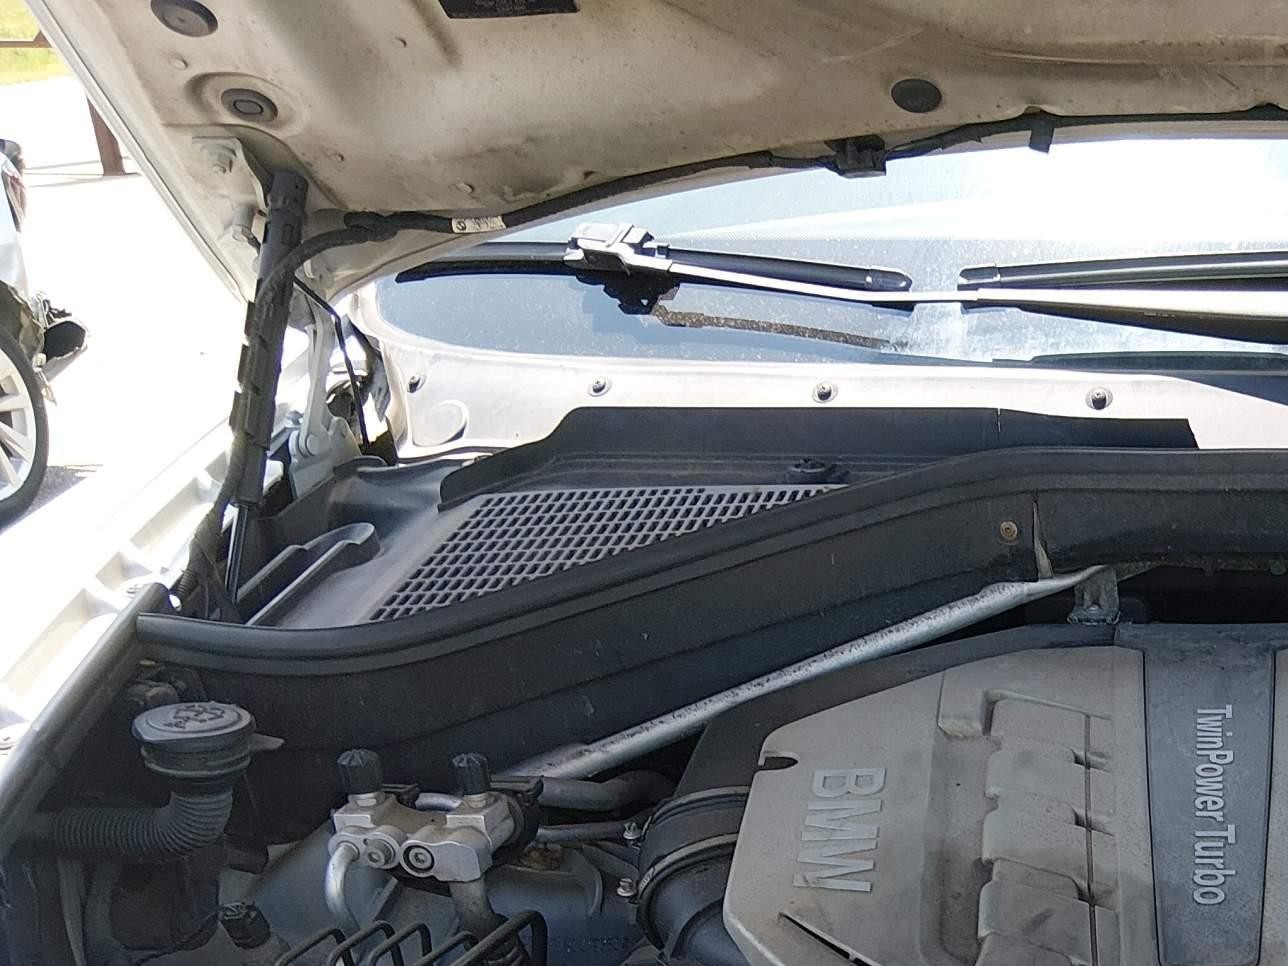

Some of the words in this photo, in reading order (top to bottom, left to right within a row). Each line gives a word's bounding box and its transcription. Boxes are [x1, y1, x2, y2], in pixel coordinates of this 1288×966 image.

[1194, 704, 1235, 822] TwinPower
[792, 767, 888, 893] BMW
[1193, 824, 1236, 907] Turbo
